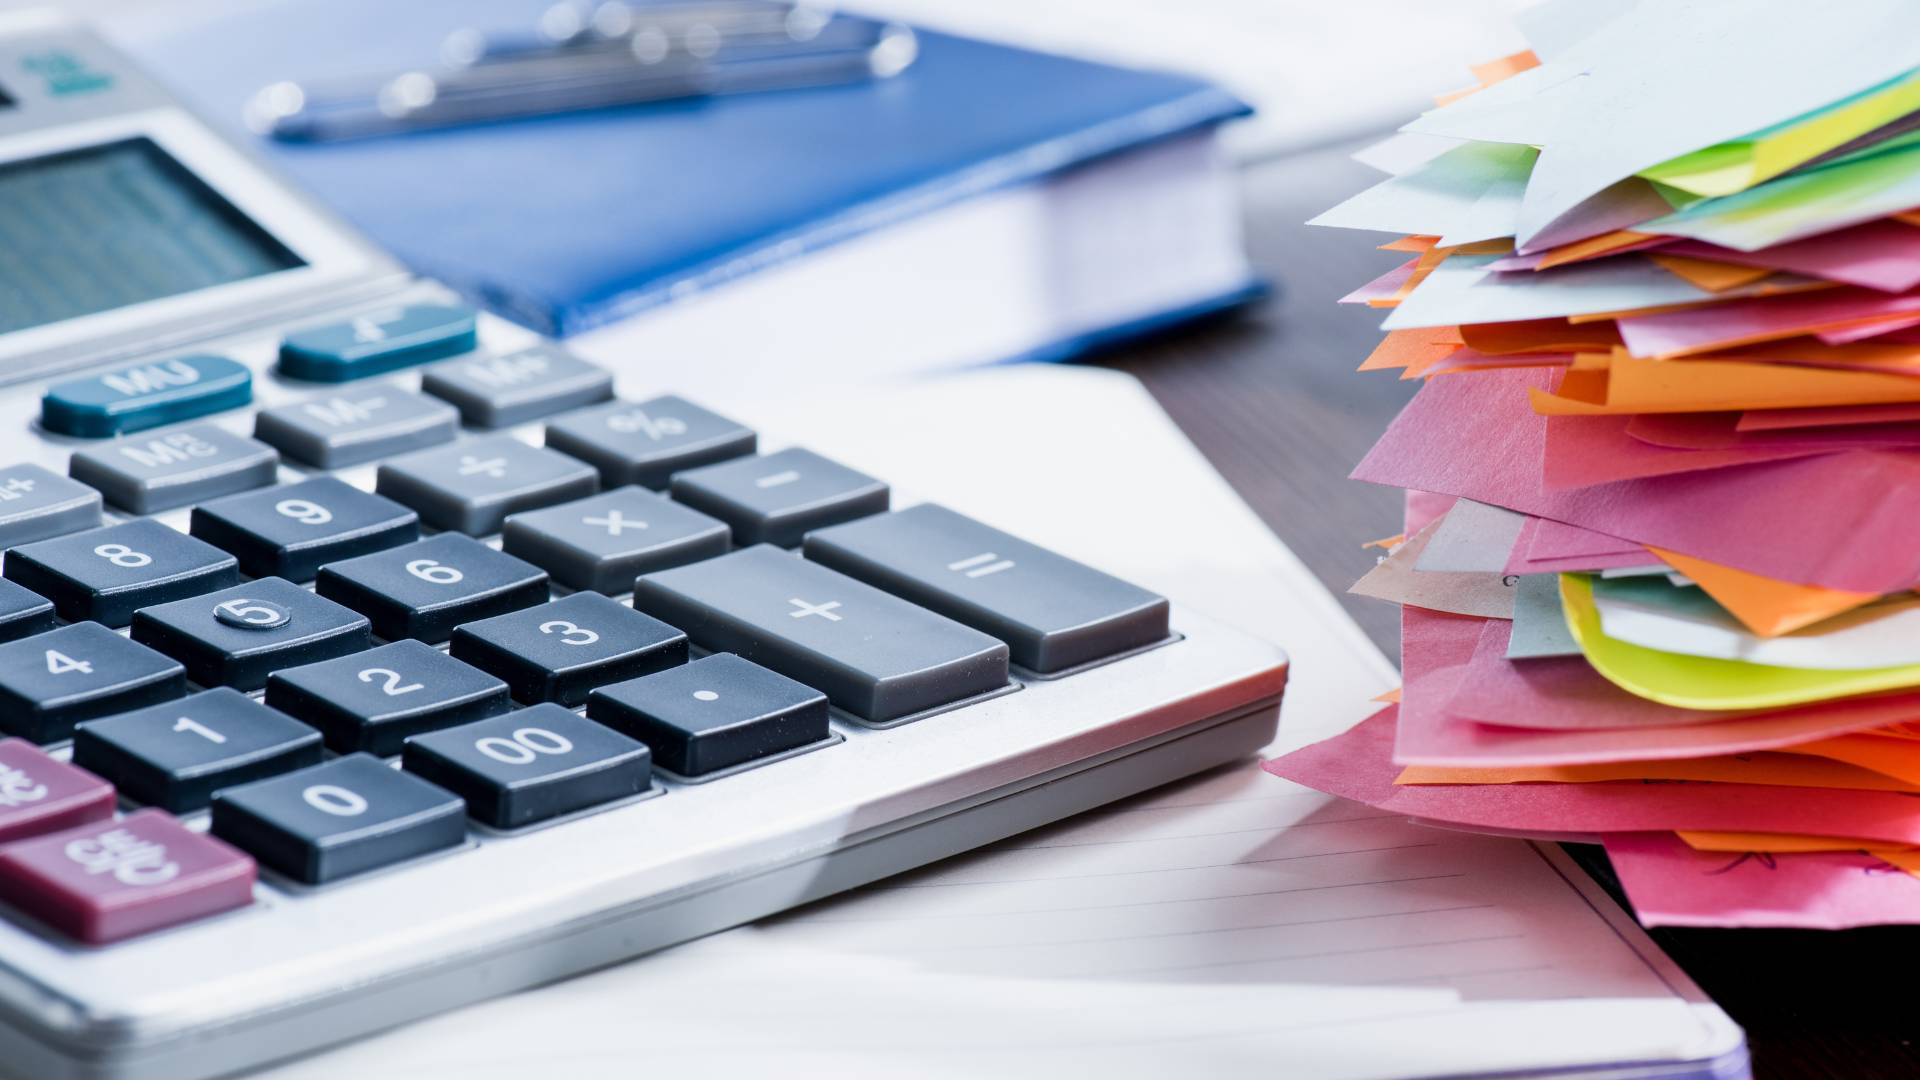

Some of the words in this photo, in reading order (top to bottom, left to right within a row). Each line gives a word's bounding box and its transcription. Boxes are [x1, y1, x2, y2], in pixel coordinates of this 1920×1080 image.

[275, 499, 333, 525] 9
[93, 543, 153, 568] 8
[405, 559, 464, 584] 6
[228, 598, 280, 625] 5
[538, 620, 600, 646] 3
[45, 649, 94, 675] 4
[357, 667, 425, 696] 2
[172, 716, 227, 744] 1
[474, 727, 574, 765] 00
[302, 784, 369, 817] 0
